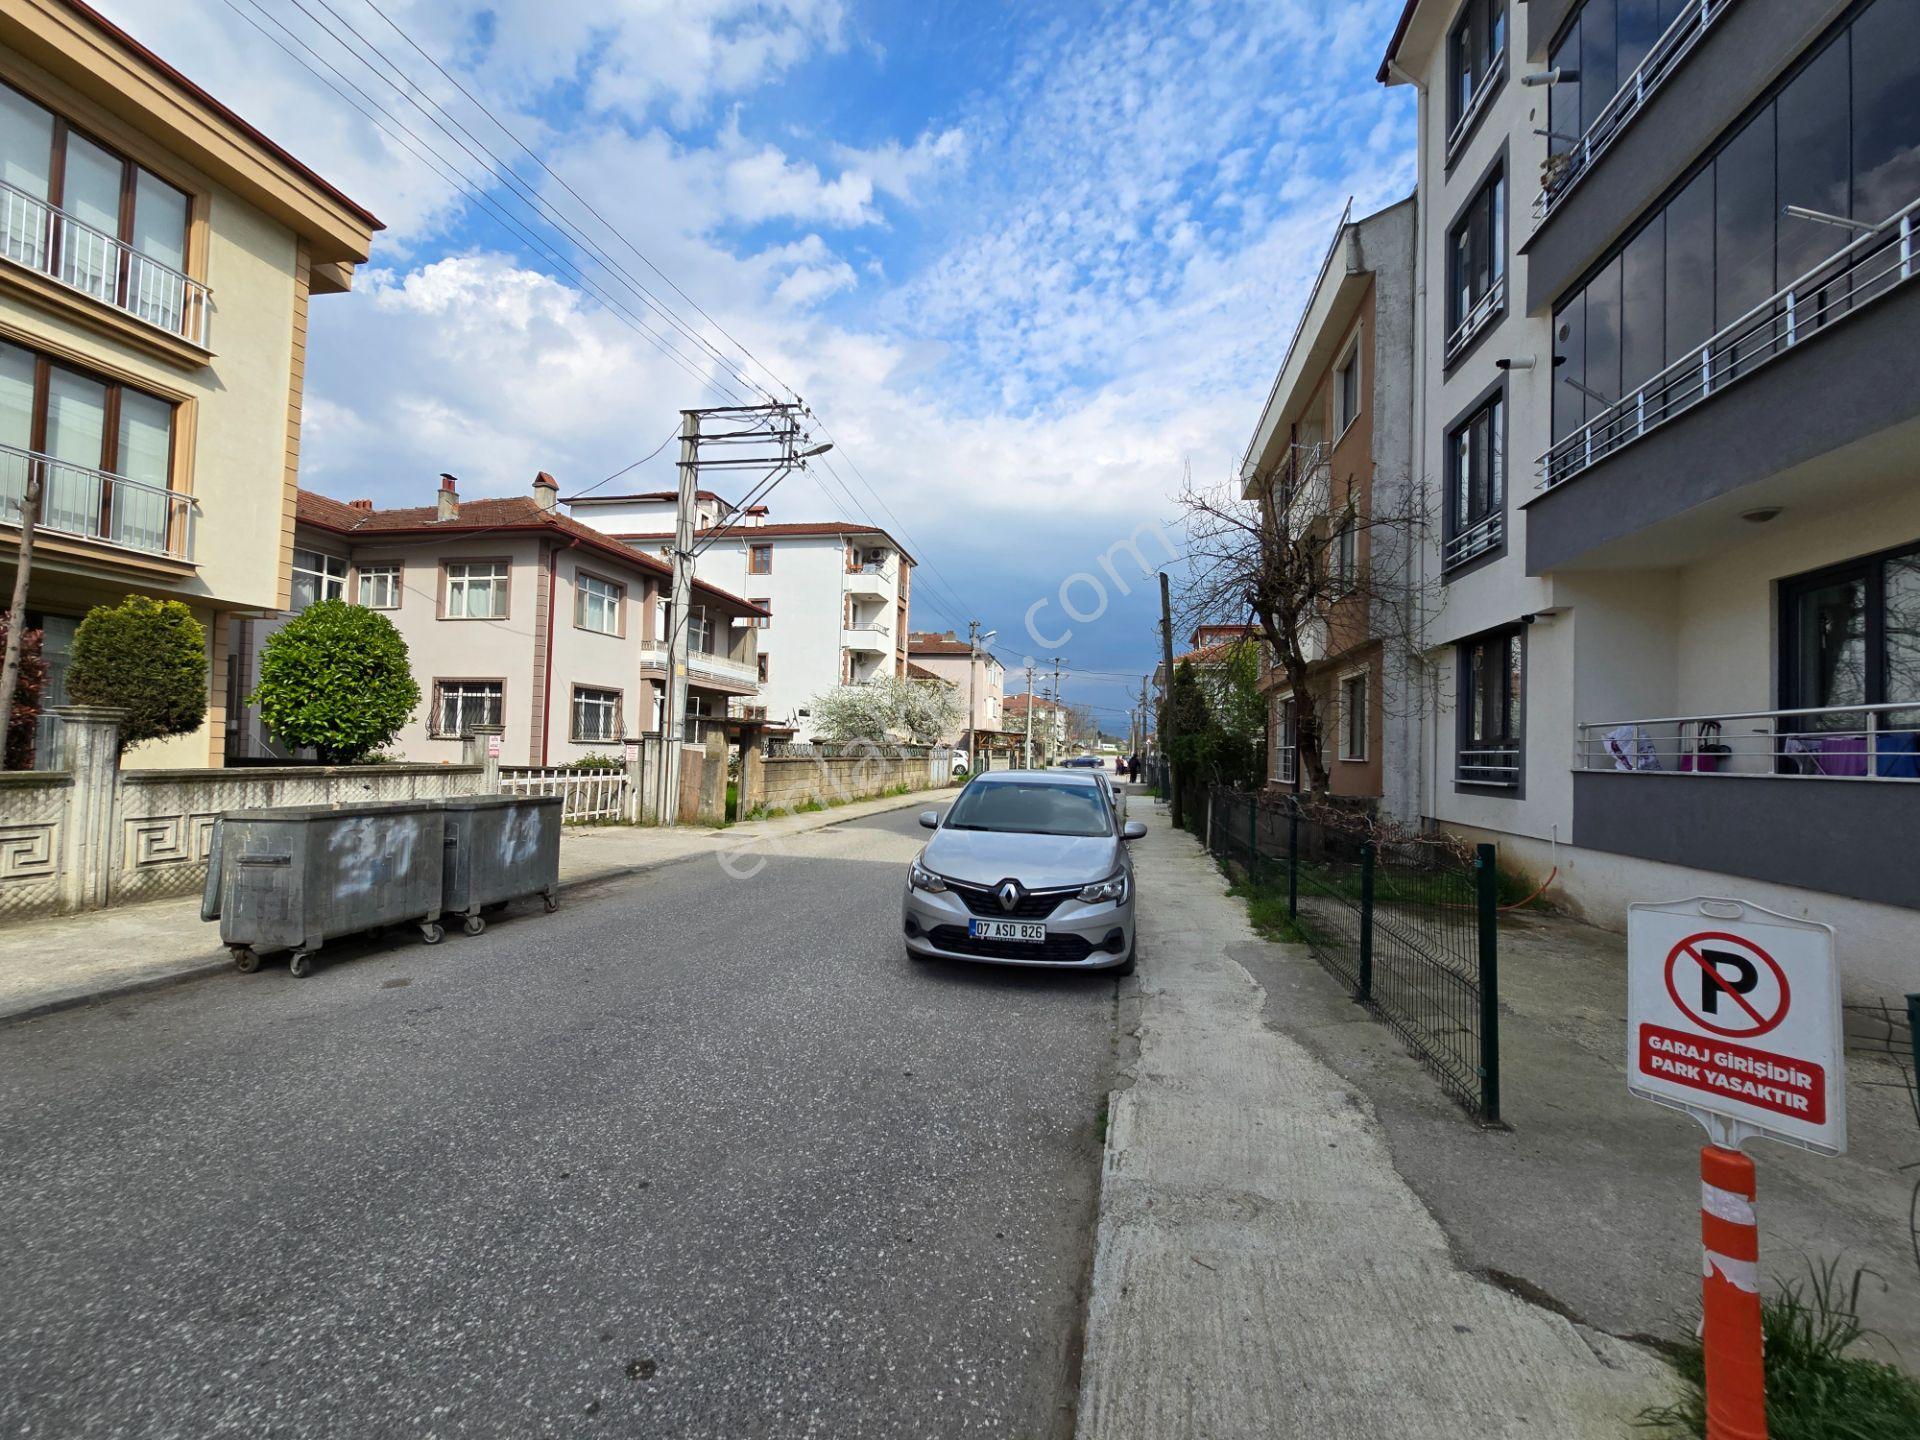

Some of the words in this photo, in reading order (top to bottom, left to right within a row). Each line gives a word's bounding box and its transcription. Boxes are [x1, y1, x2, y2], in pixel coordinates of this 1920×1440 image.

[977, 923, 990, 936] 07
[995, 924, 1016, 937] ASD
[1021, 926, 1043, 939] 826
[1701, 948, 1758, 1015] P
[1648, 1035, 1710, 1062] GARAJ
[1714, 1051, 1812, 1090] GİRİŞİDİR
[1651, 1055, 1700, 1081] PARK
[1704, 1069, 1809, 1112] YASAKTIR
